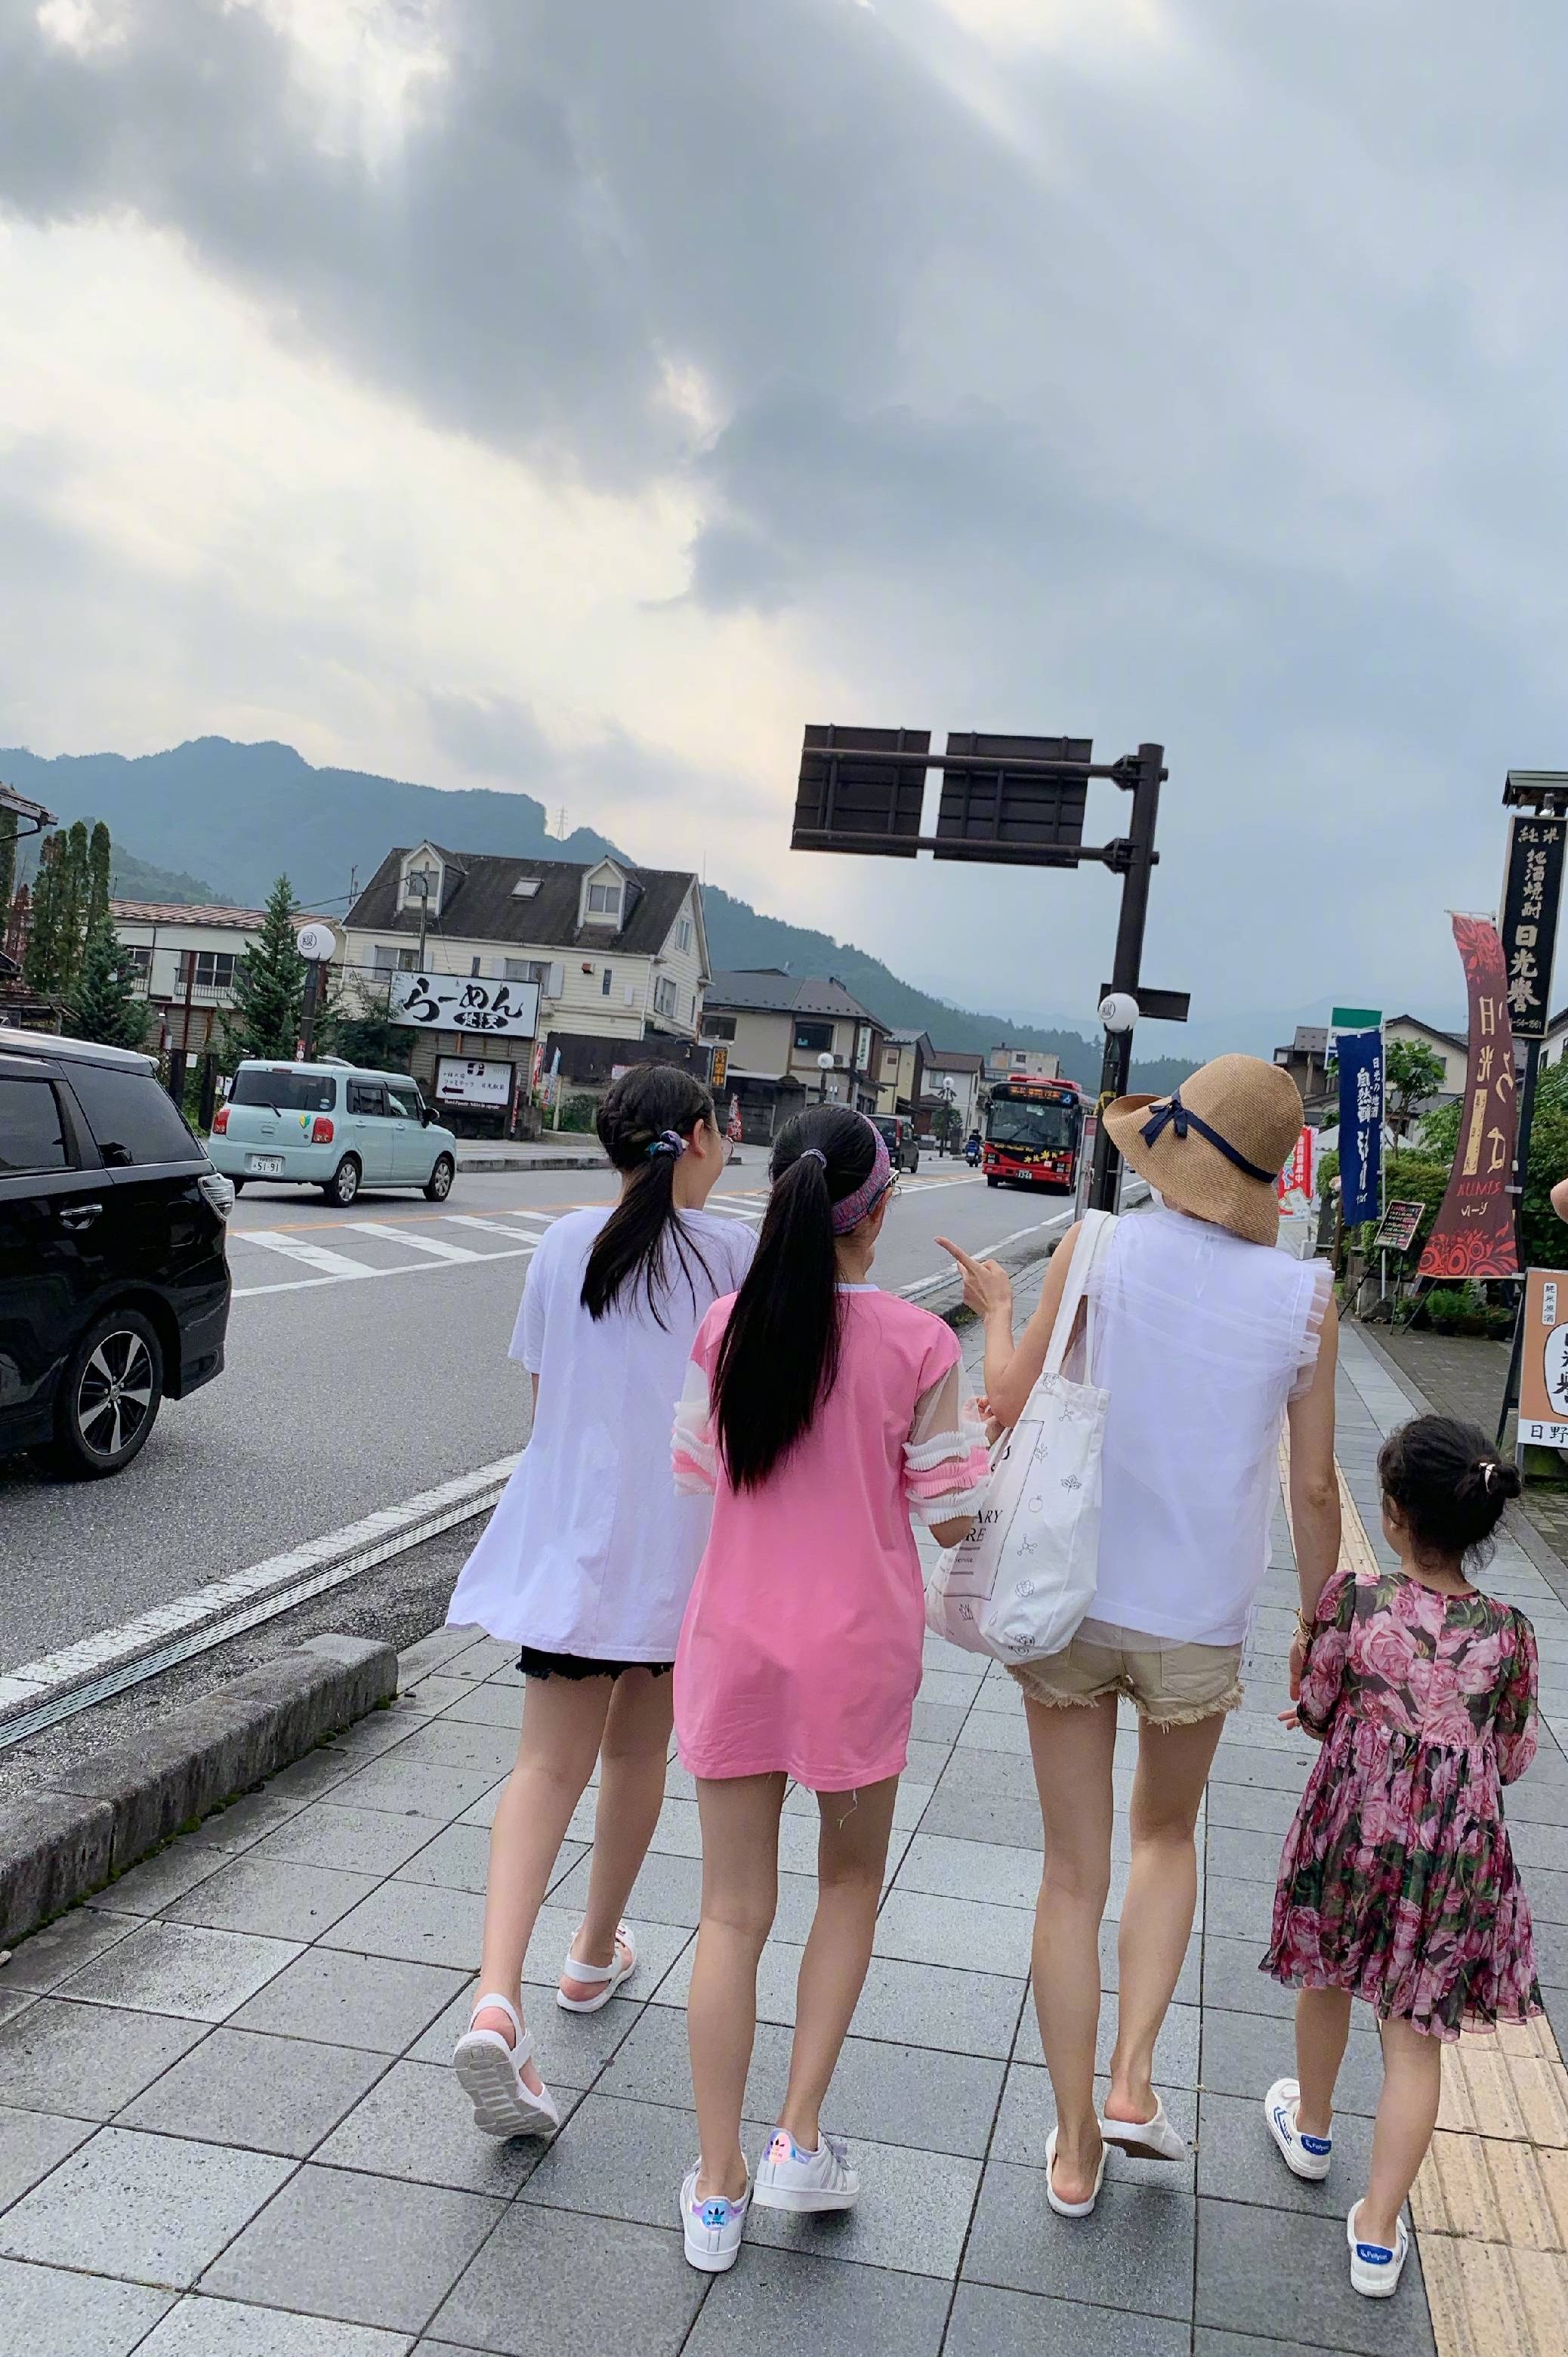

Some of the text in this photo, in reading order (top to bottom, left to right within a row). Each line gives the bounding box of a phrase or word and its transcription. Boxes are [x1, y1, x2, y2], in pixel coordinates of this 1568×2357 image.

[403, 977, 524, 1022] らーめん
[258, 1162, 279, 1172] 51-91
